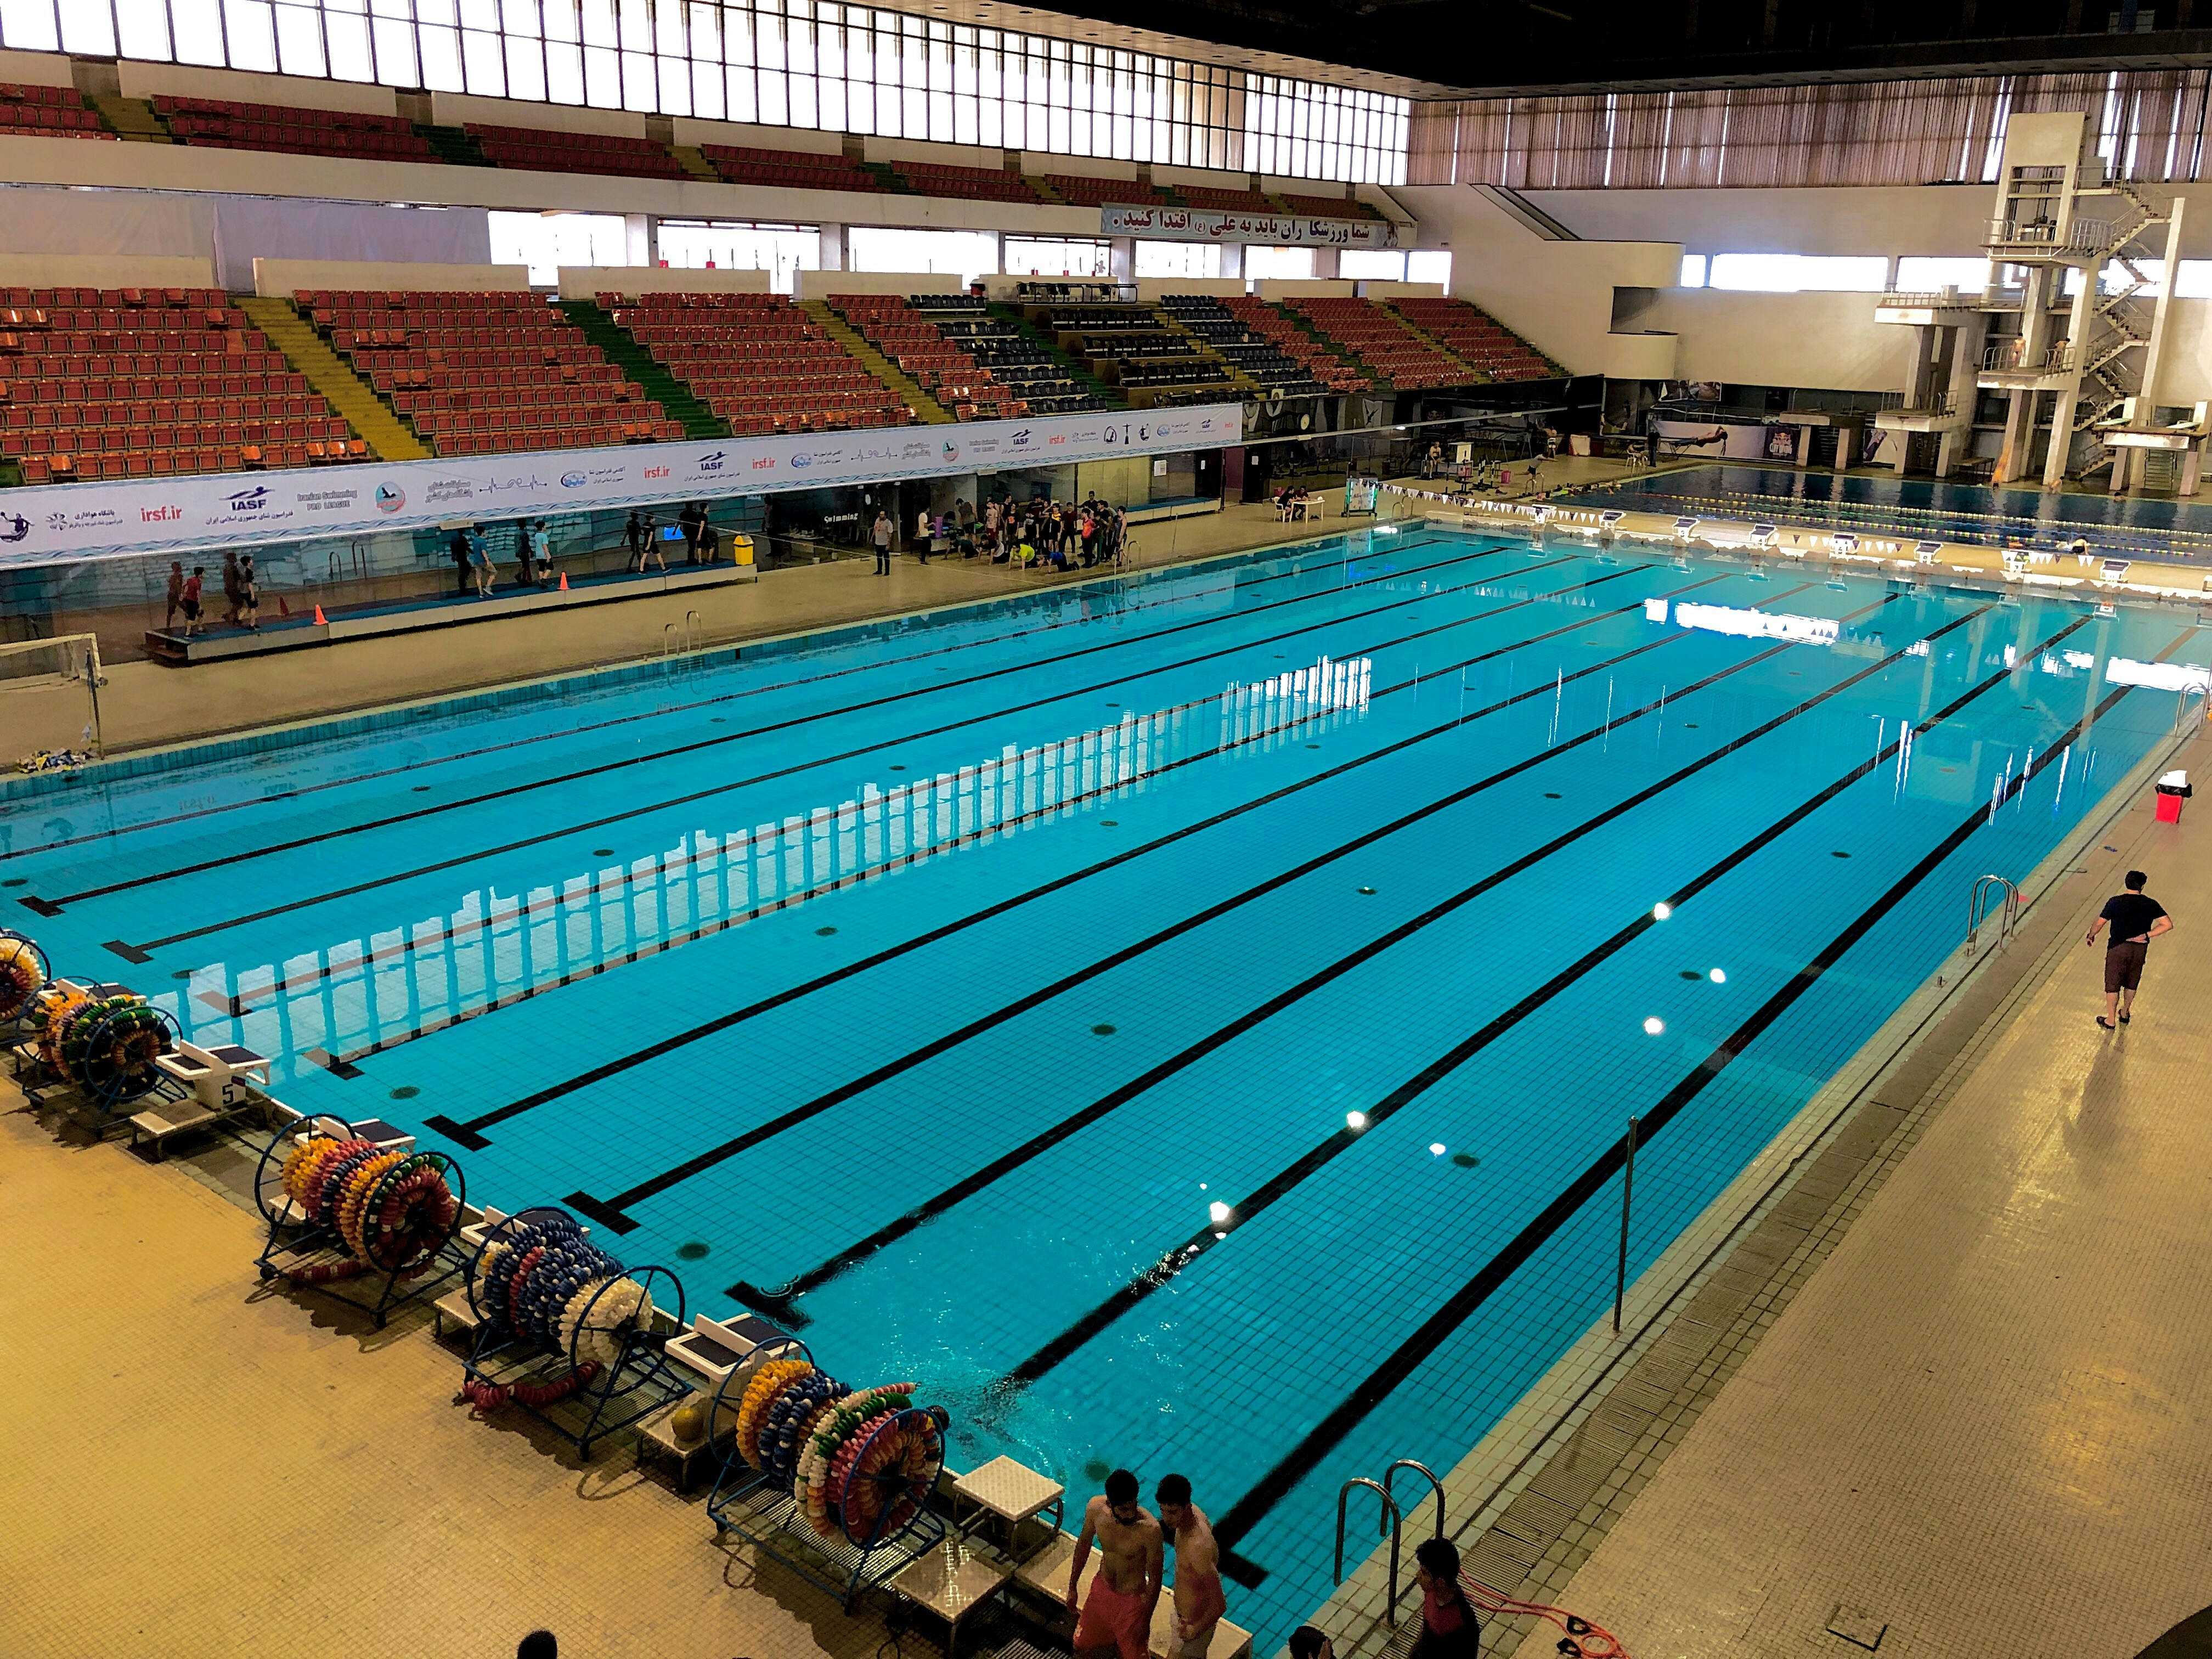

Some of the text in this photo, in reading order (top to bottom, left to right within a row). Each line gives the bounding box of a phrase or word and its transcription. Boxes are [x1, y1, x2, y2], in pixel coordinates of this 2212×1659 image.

[1159, 210, 1191, 228] اقتدا
[1210, 215, 1236, 236] علی
[1240, 219, 1251, 237] به
[1255, 218, 1278, 238] باید
[1352, 223, 1369, 239] شما
[1048, 435, 1066, 445] irsf.ir
[701, 461, 723, 471] IASF
[752, 456, 776, 469] irsf.ir
[644, 466, 670, 479] irsf.ir
[297, 489, 358, 501] Iranian Swimming
[232, 499, 266, 511] IASF
[307, 500, 351, 511] PRO LEAGUE
[140, 505, 182, 522] irsf.ir
[824, 512, 859, 524] Swimming
[222, 1084, 234, 1104] 5
